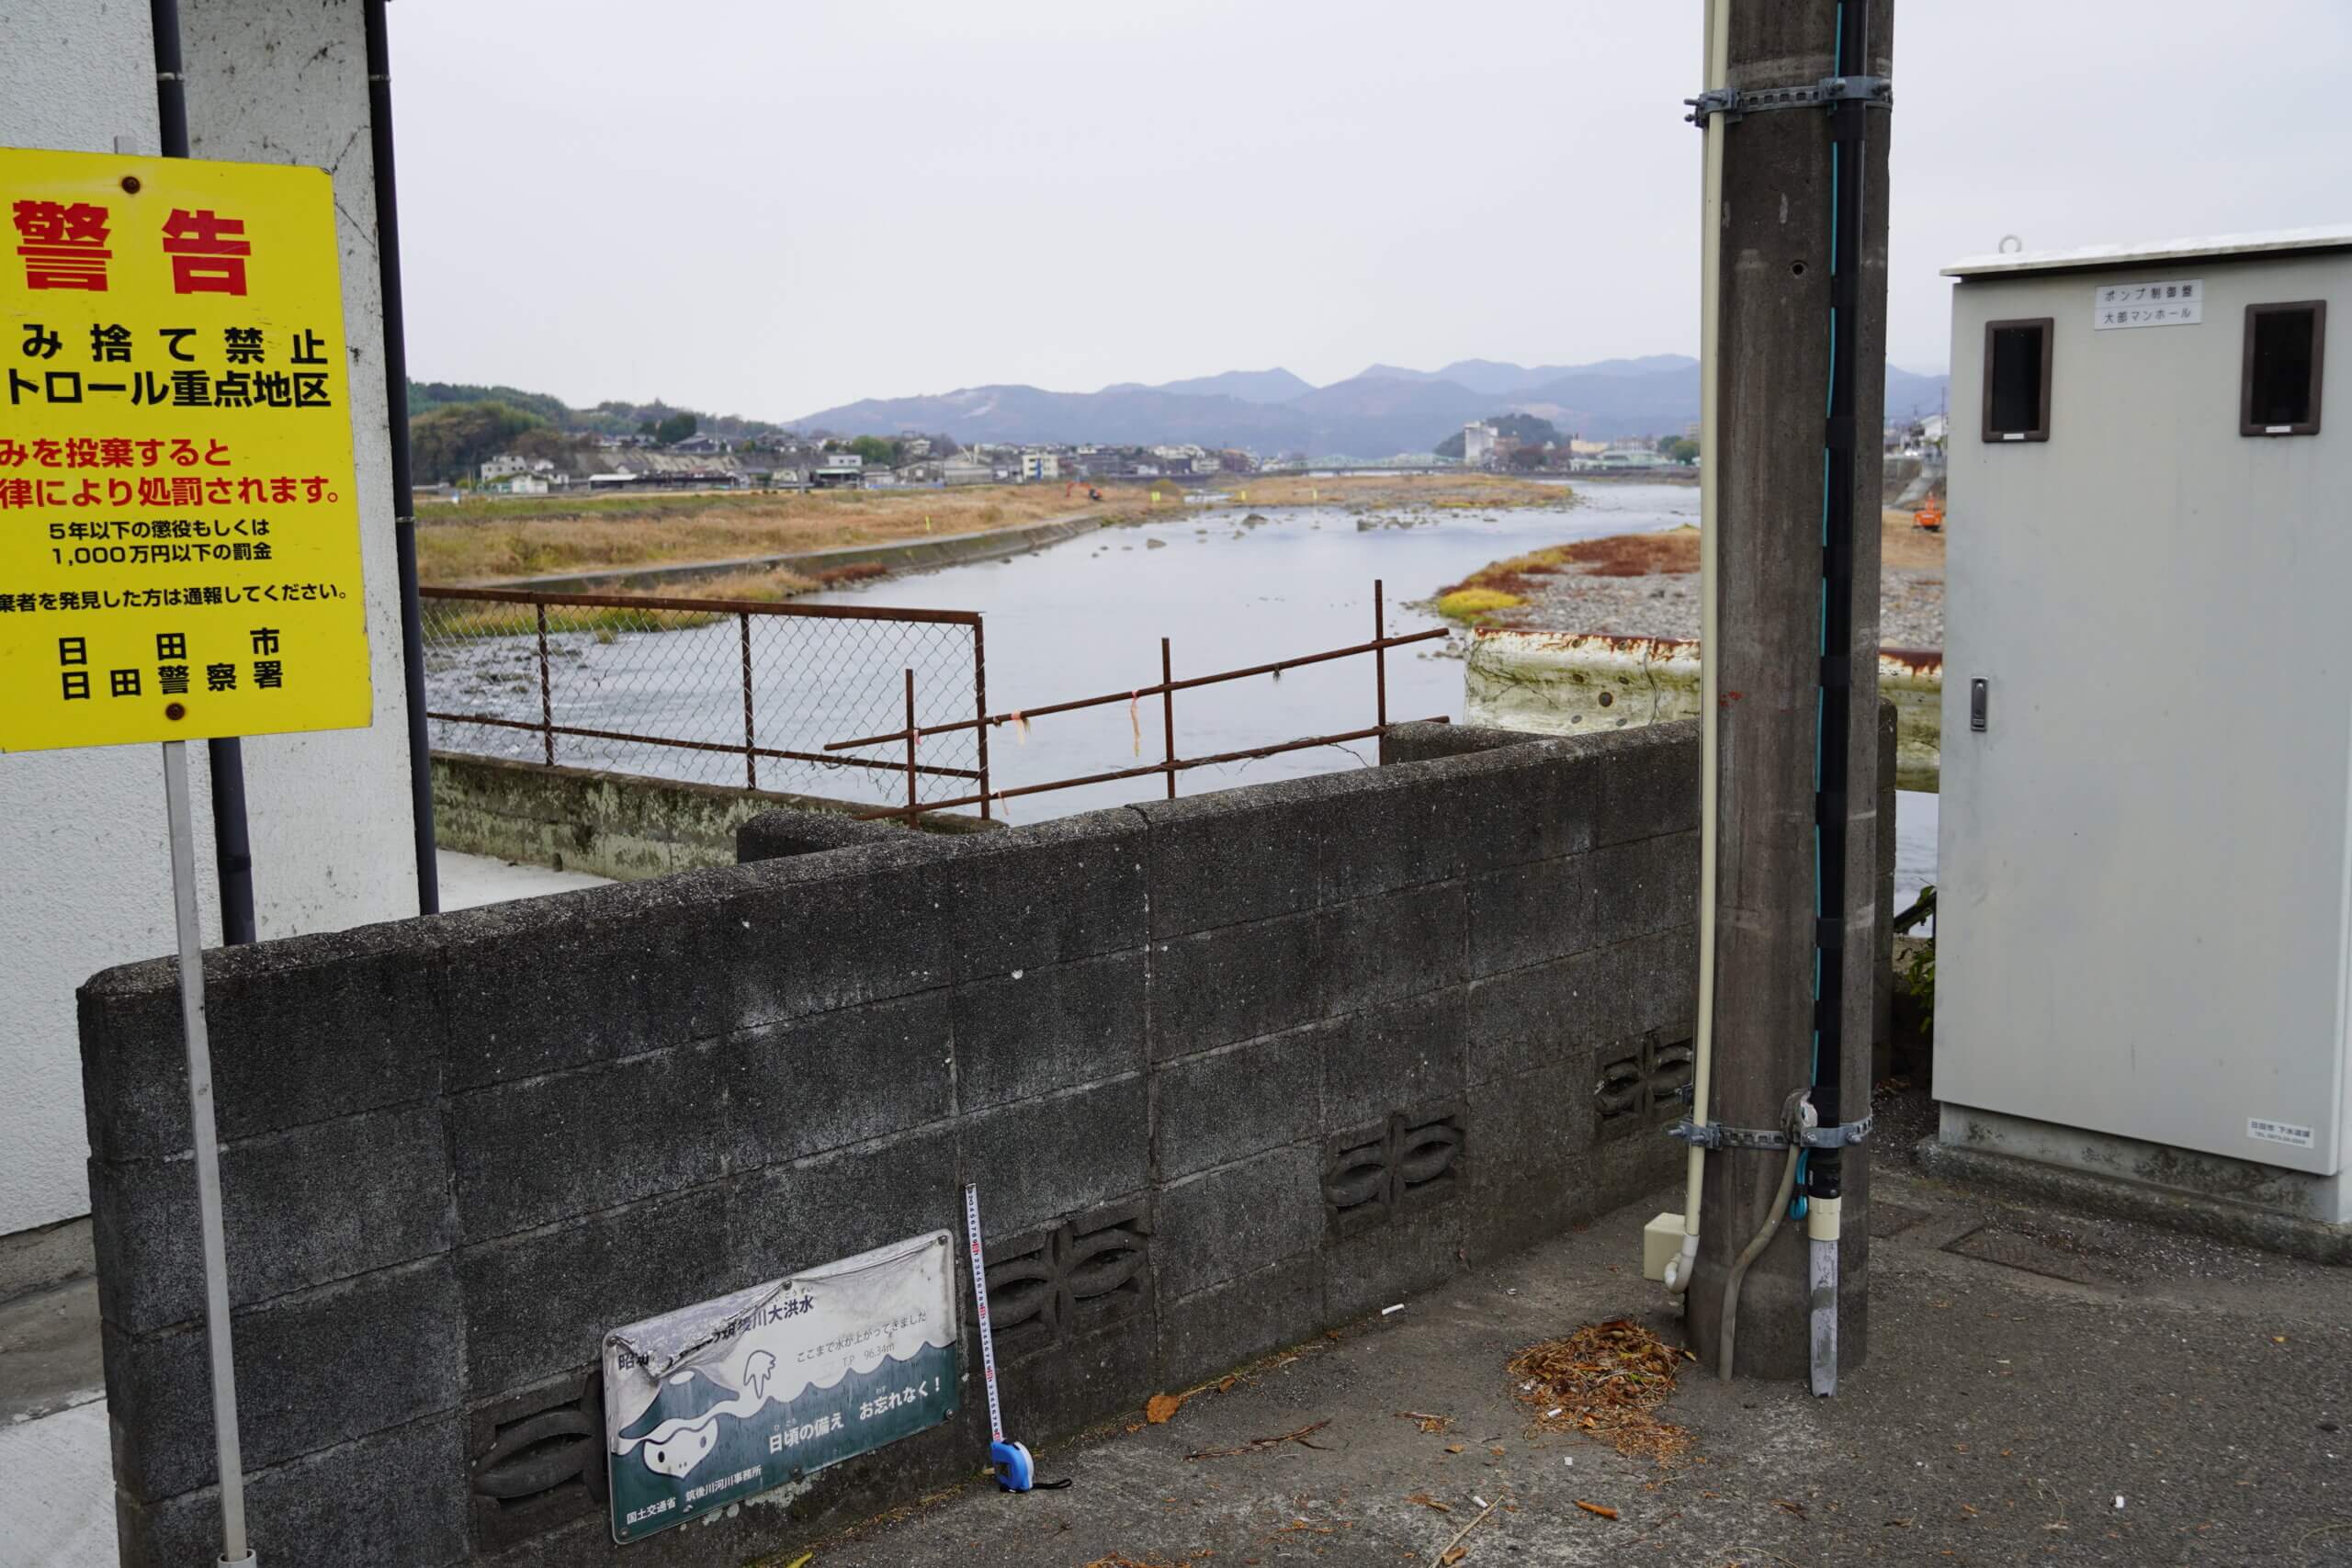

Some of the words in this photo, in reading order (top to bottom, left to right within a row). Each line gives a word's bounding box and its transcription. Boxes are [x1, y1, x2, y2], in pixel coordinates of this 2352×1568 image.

[12, 199, 252, 296] 警告
[22, 323, 328, 366] み捨て禁止
[8, 368, 332, 408] トロール重点地区
[0, 437, 232, 468] みを投棄すると
[0, 476, 339, 509] 律により処罰されます。
[49, 518, 270, 540] 5年以下の懲役もしくは
[51, 542, 273, 567] 1,000万円以下の罰金
[0, 582, 347, 614] 棄者を発見した方は通報してください。
[59, 627, 280, 666] 日田市
[62, 660, 284, 701] 日田警察署
[797, 1311, 927, 1363] ここまで水が上がってきました
[769, 1412, 844, 1455] 日頃の備え
[627, 1496, 677, 1525] 国土交通省
